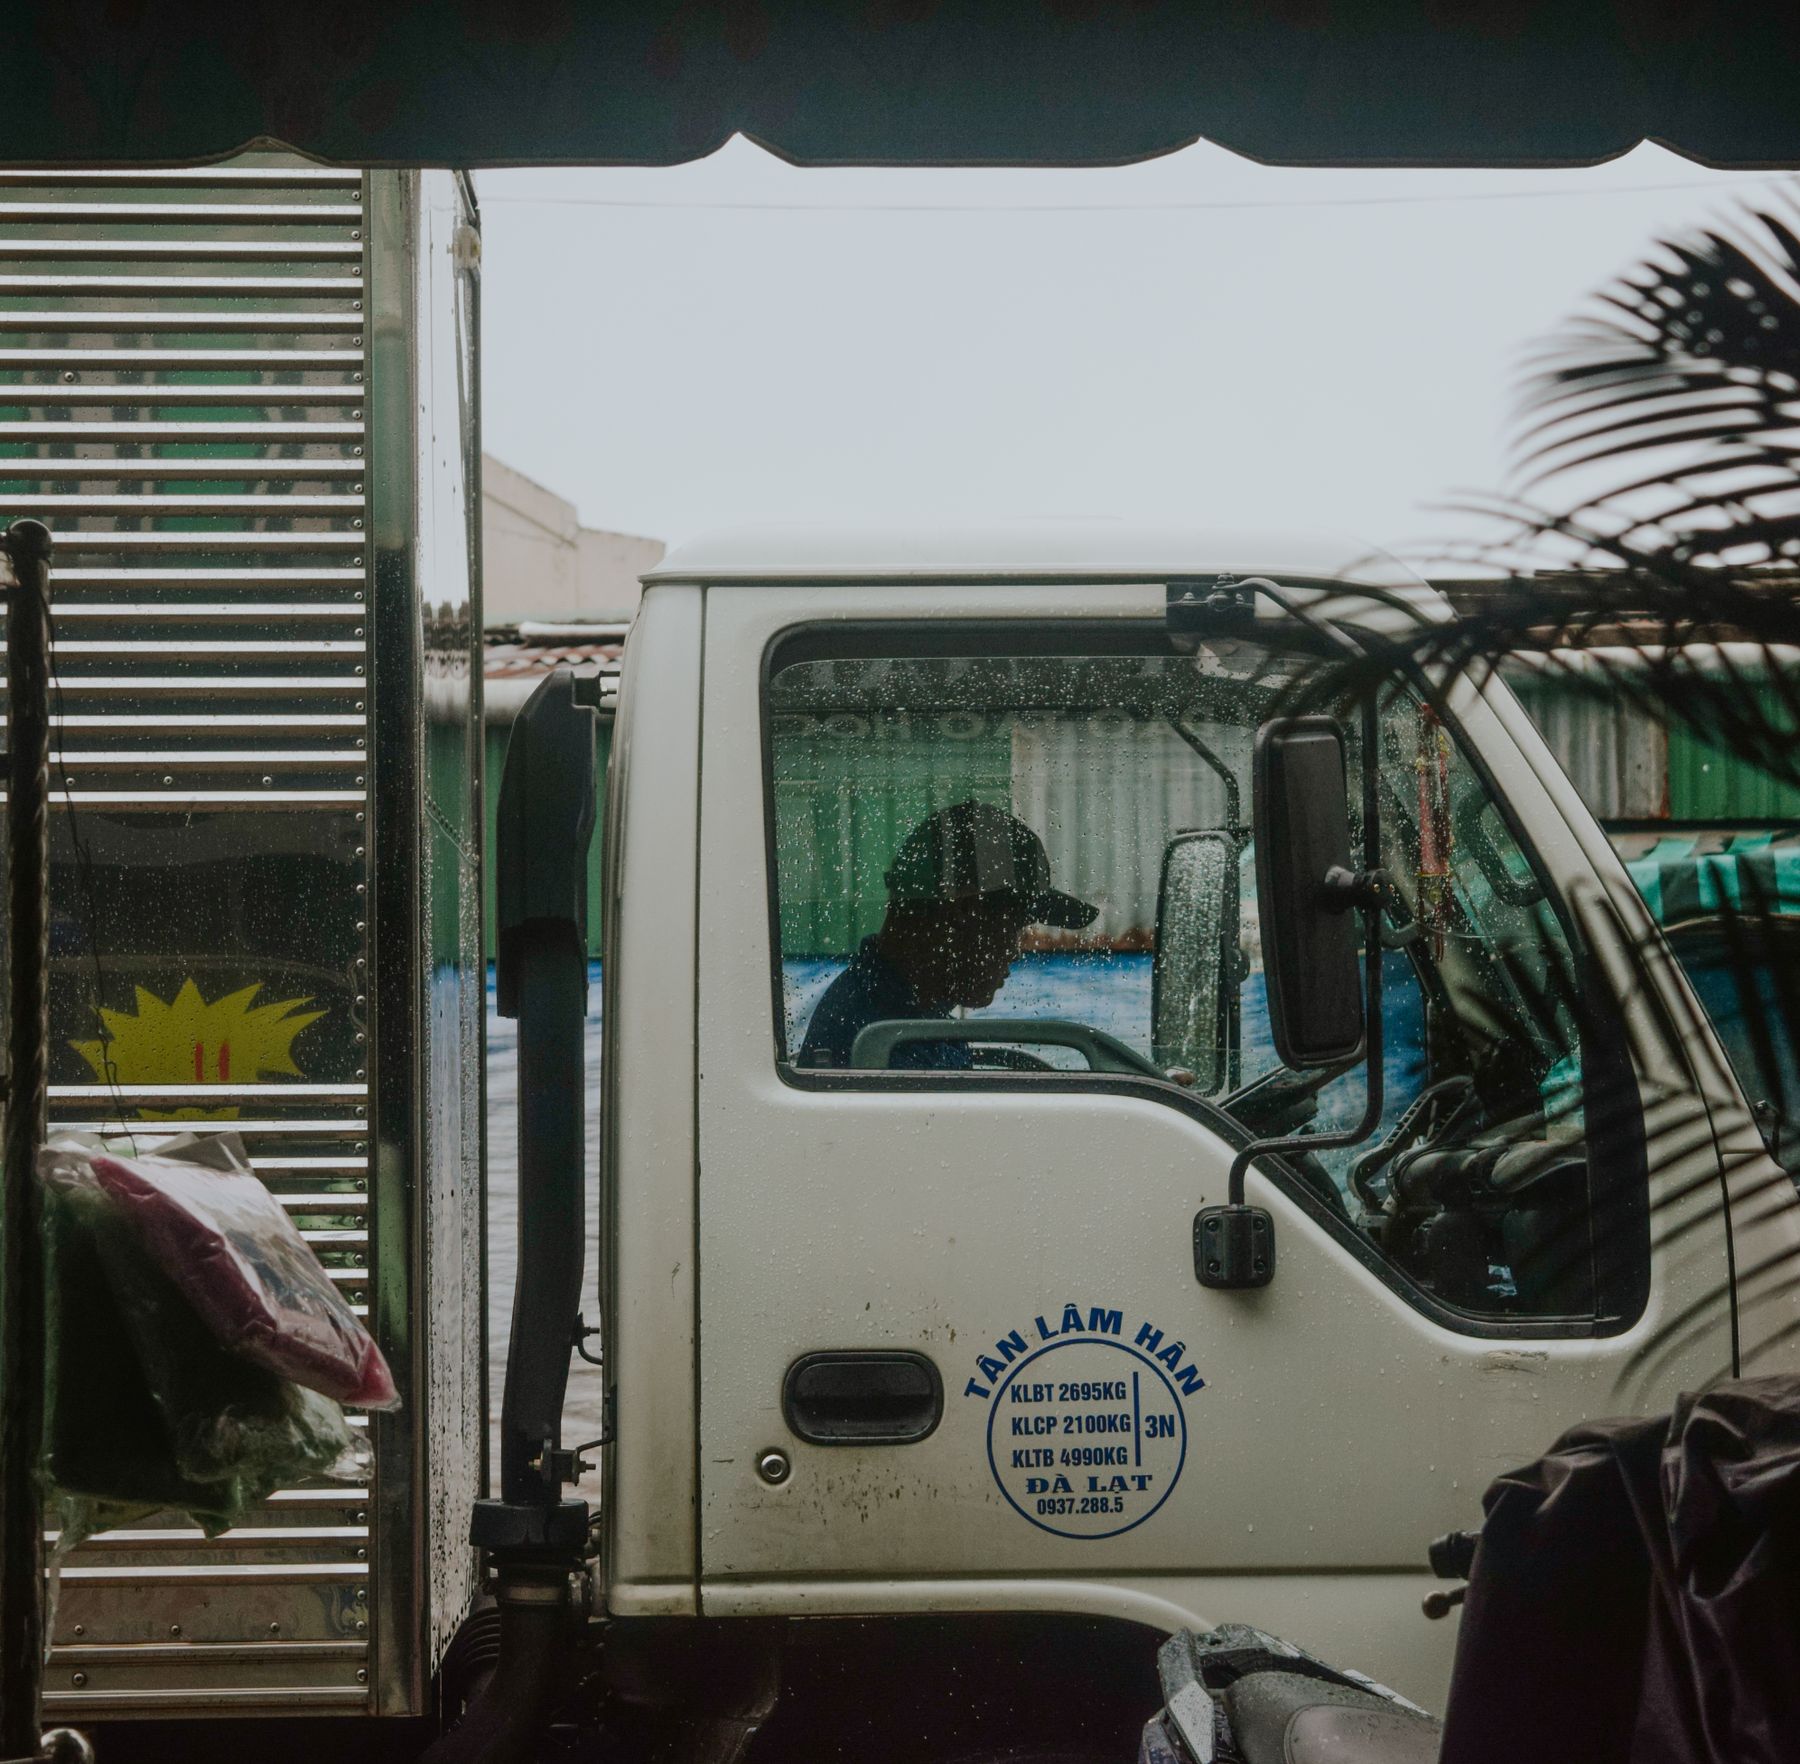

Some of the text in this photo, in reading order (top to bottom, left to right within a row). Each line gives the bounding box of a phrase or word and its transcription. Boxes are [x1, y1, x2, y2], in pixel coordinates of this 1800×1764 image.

[963, 1303, 1205, 1400] TÂN LÂM HÂN
[1010, 1381, 1127, 1403] KLBT 2695KG
[1011, 1414, 1131, 1436] KLCP 2100KG
[1145, 1414, 1175, 1438] 3N
[1012, 1446, 1128, 1468] KLTB 4990KG
[1026, 1474, 1153, 1494] ĐÀ LẠT
[1037, 1497, 1123, 1515] 0937.288.5
